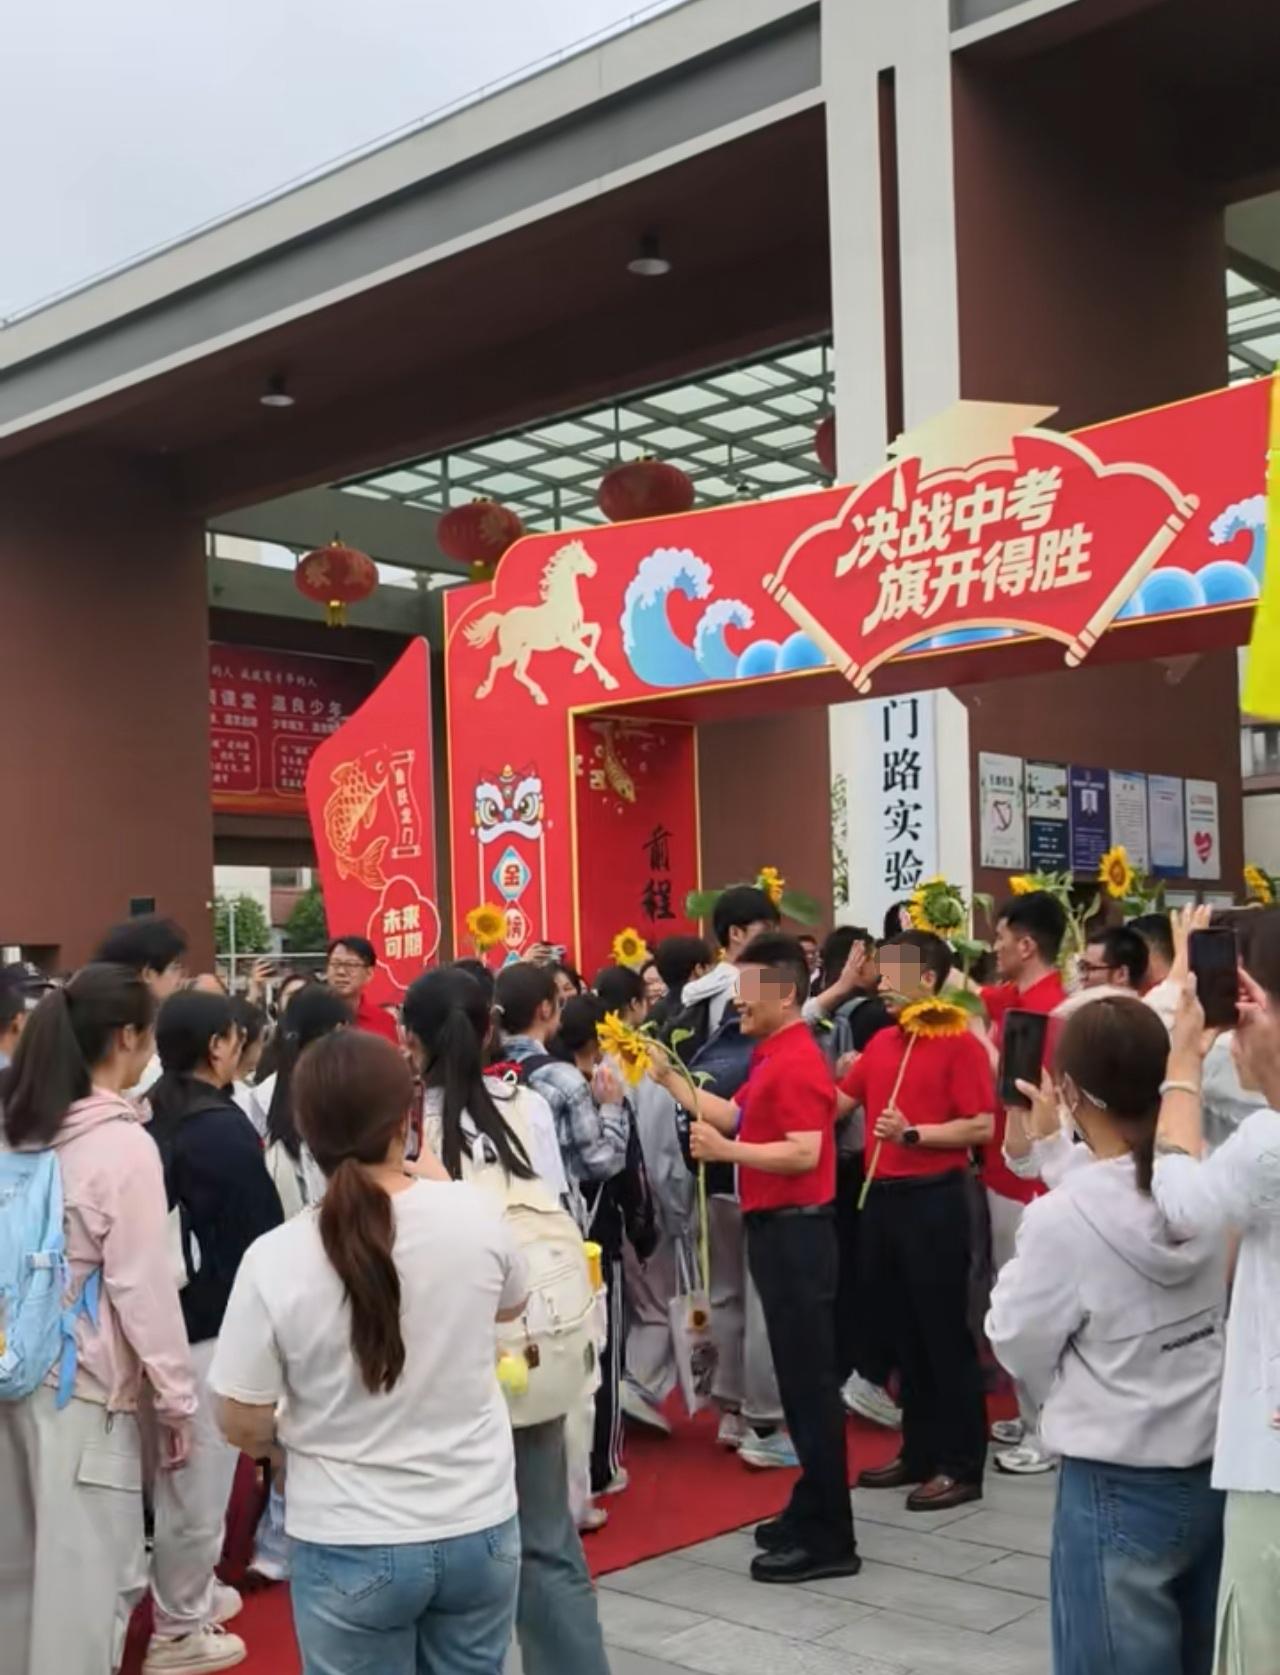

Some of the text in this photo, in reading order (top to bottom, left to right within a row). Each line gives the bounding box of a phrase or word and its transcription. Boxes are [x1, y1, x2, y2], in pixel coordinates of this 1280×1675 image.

[836, 466, 1063, 578] 决战中考
[861, 522, 1093, 636] 旗开得胜
[883, 698, 923, 892] 门路实验
[383, 904, 420, 934] 未来
[384, 931, 423, 960] 可期
